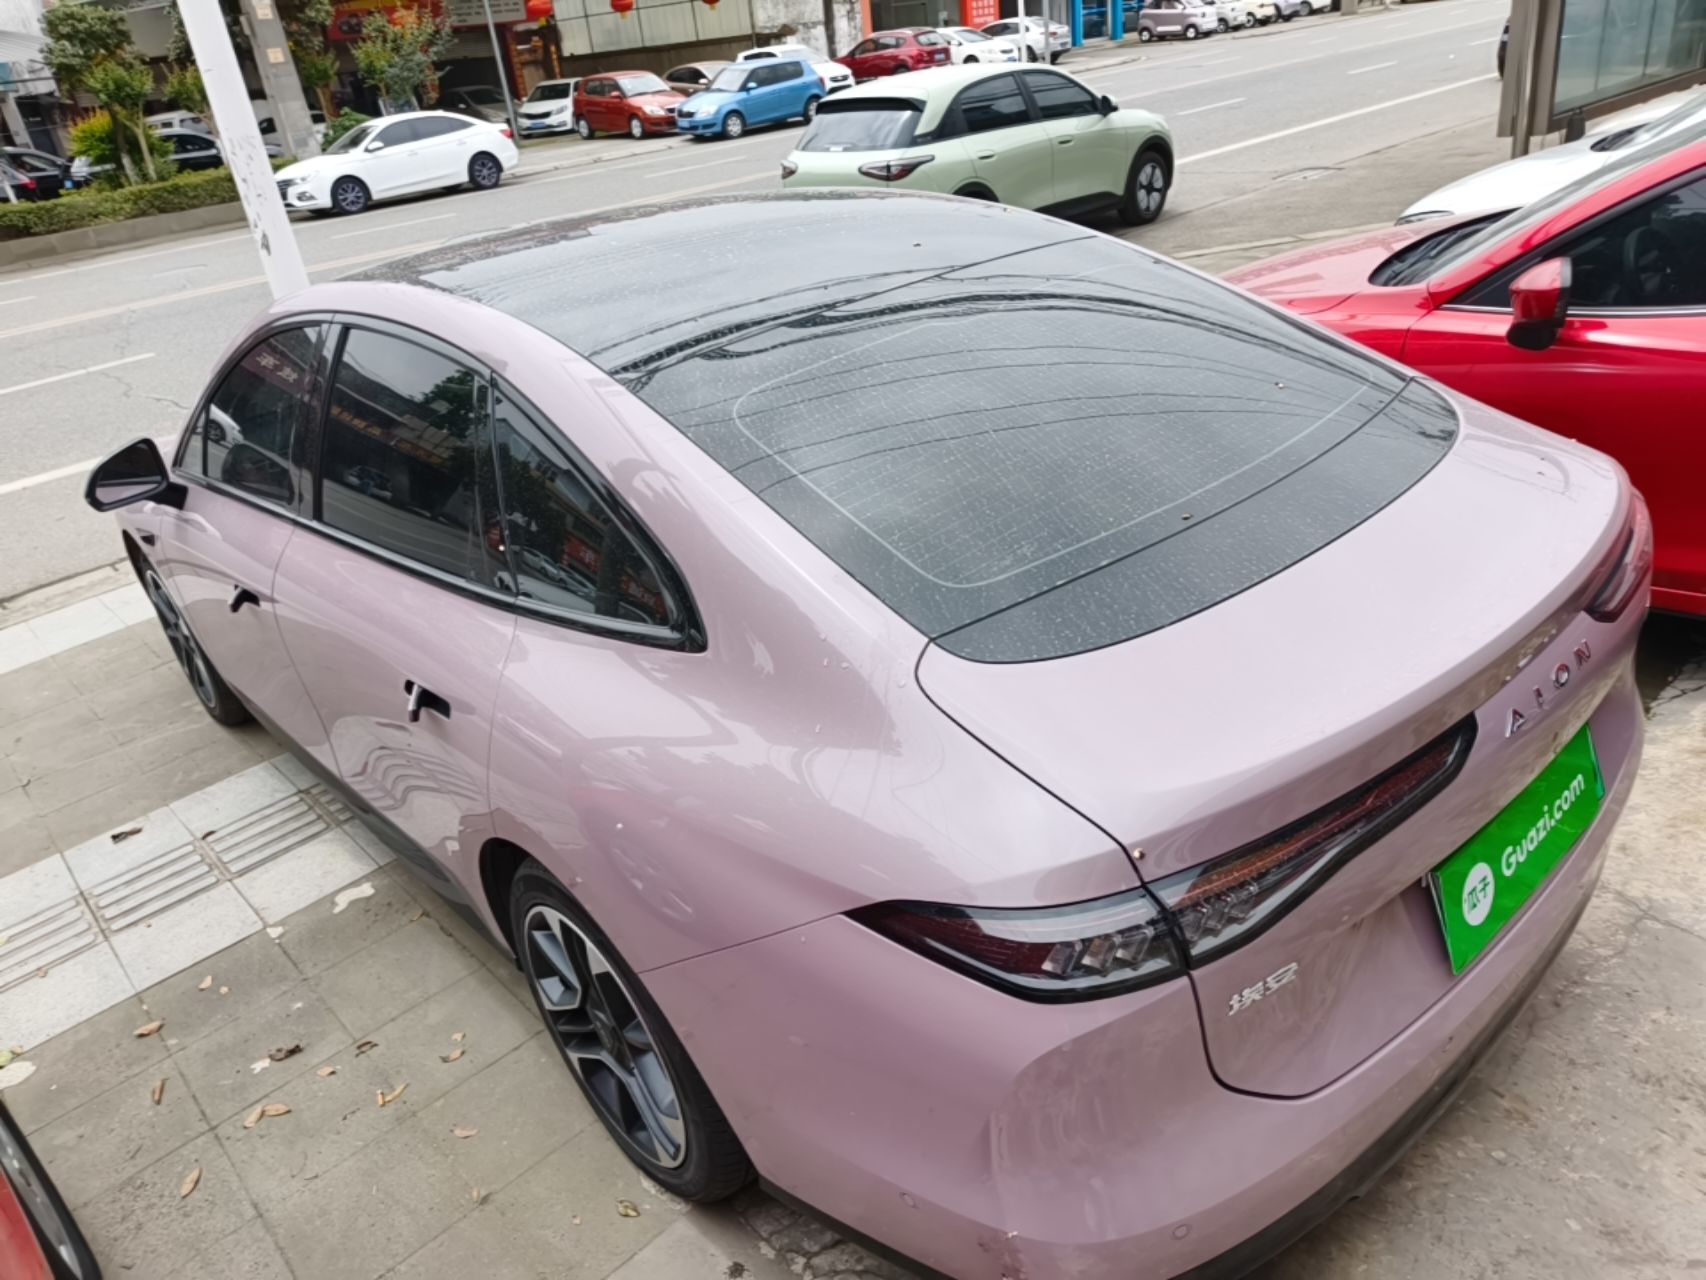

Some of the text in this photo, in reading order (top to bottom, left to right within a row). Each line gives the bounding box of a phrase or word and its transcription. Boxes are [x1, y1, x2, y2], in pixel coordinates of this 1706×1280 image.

[1505, 639, 1591, 738] AION
[1501, 774, 1585, 878] Guazi.com
[1464, 875, 1490, 913] 瓜子
[1228, 961, 1298, 1017] 埃安
